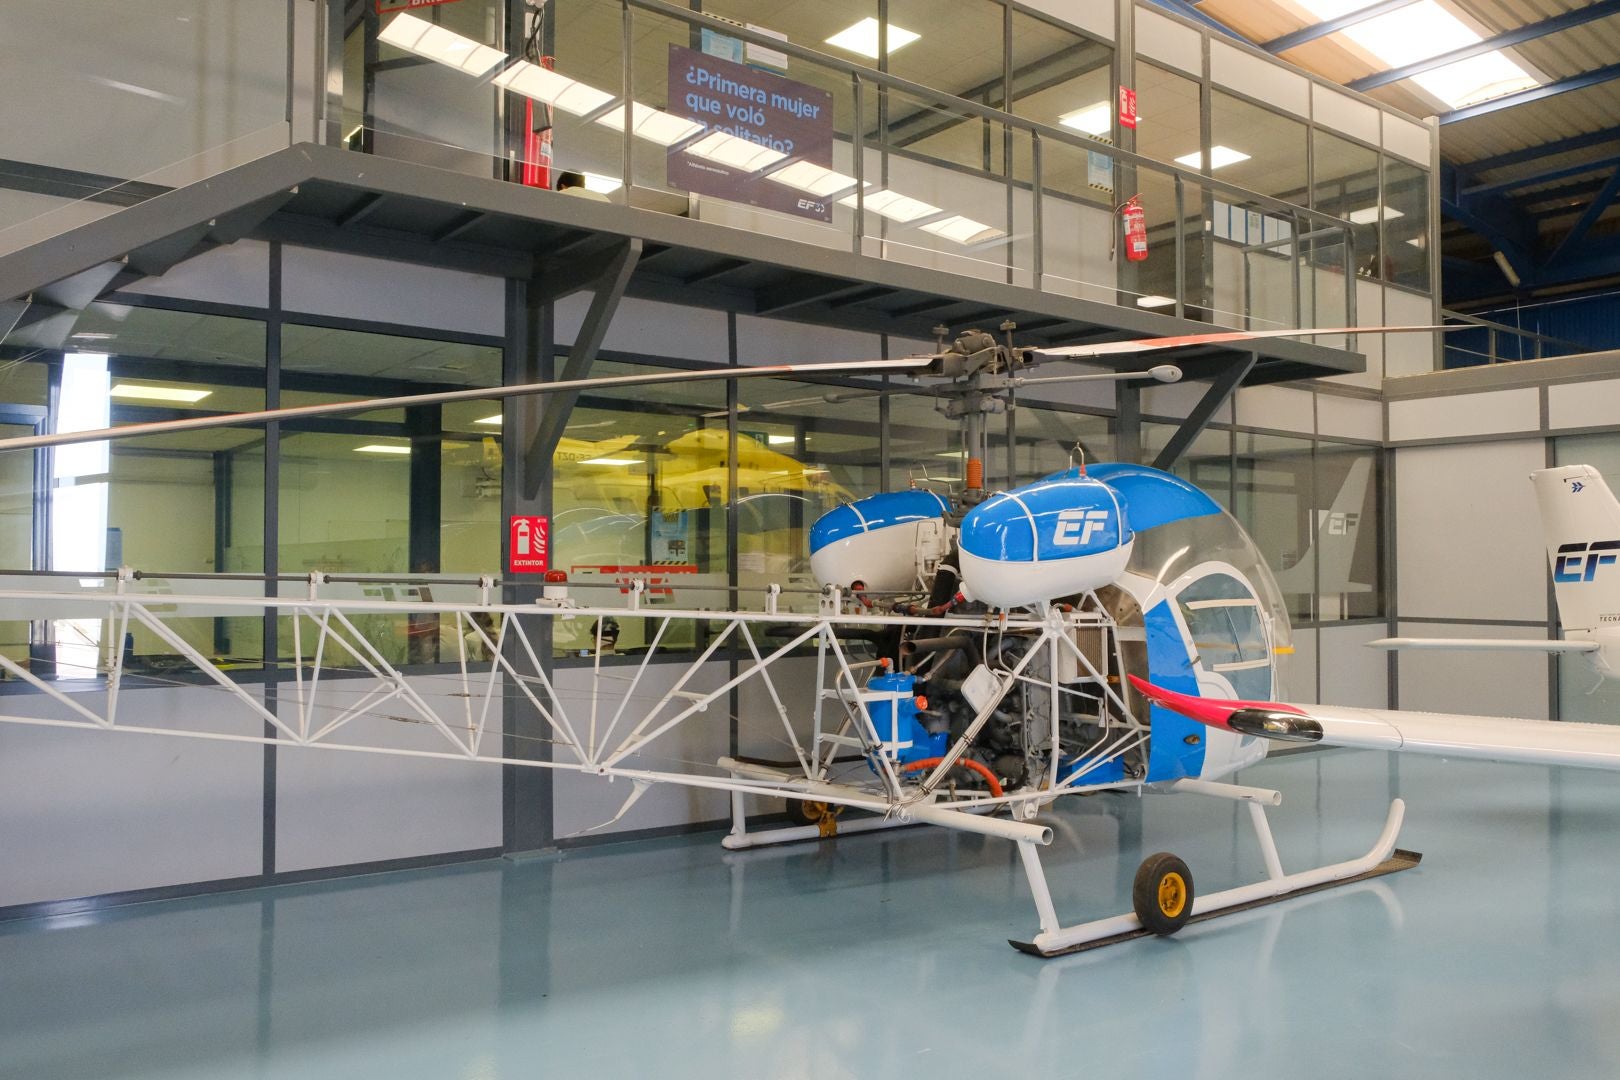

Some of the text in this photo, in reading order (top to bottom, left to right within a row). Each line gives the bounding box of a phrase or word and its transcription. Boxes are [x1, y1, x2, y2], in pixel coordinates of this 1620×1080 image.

[685, 92, 766, 127] que voló
[686, 65, 820, 119] ¿Primera mujer
[1053, 510, 1109, 545] EF
[1328, 512, 1359, 535] EF
[1554, 540, 1620, 583] EF
